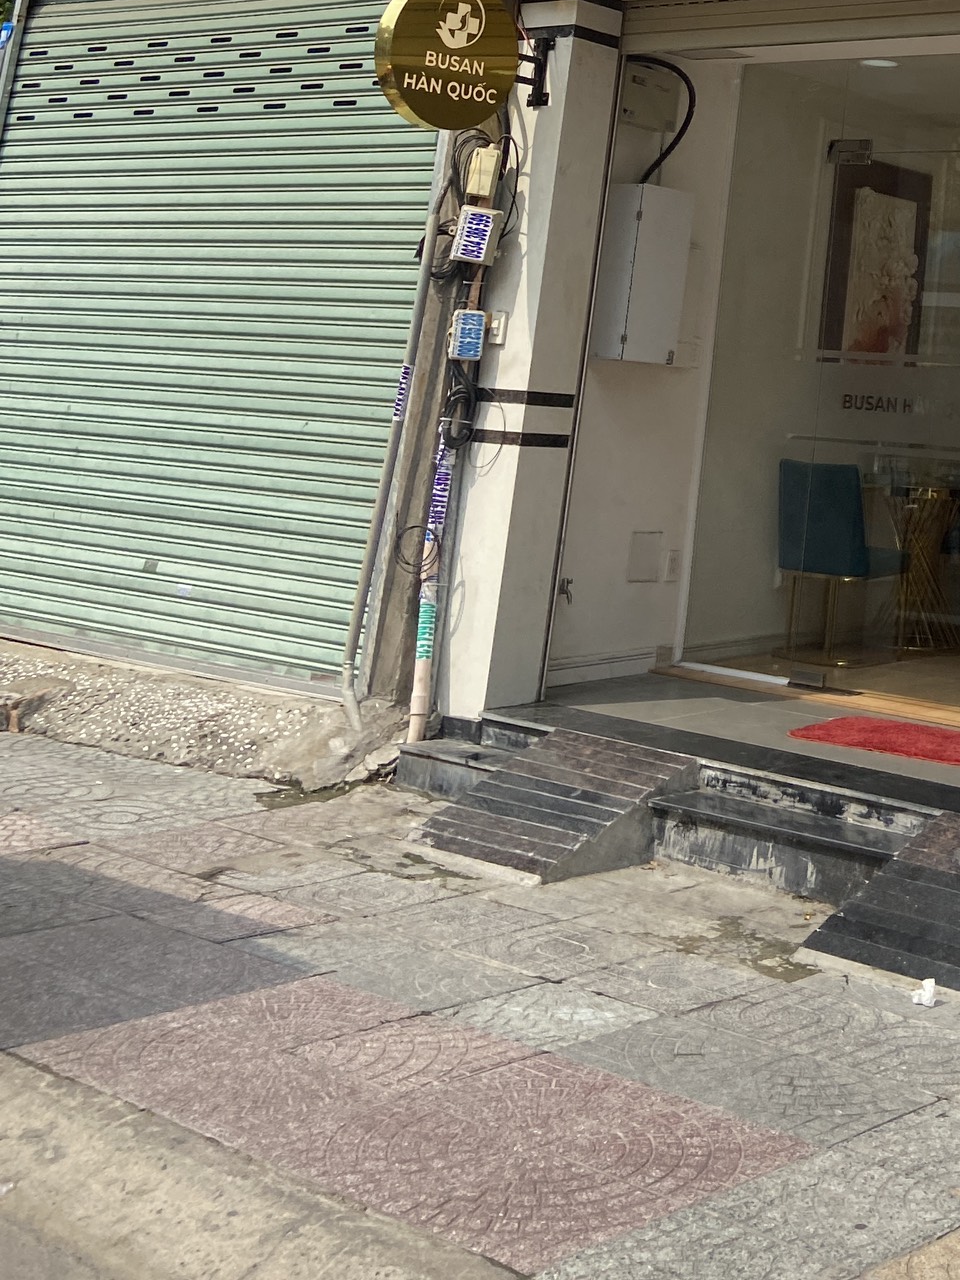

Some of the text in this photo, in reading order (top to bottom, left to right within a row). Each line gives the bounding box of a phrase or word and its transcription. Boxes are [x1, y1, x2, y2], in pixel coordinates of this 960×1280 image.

[425, 51, 484, 76] BUSAN
[403, 72, 498, 104] HÀN QUỐC
[842, 393, 898, 413] BUSAN
